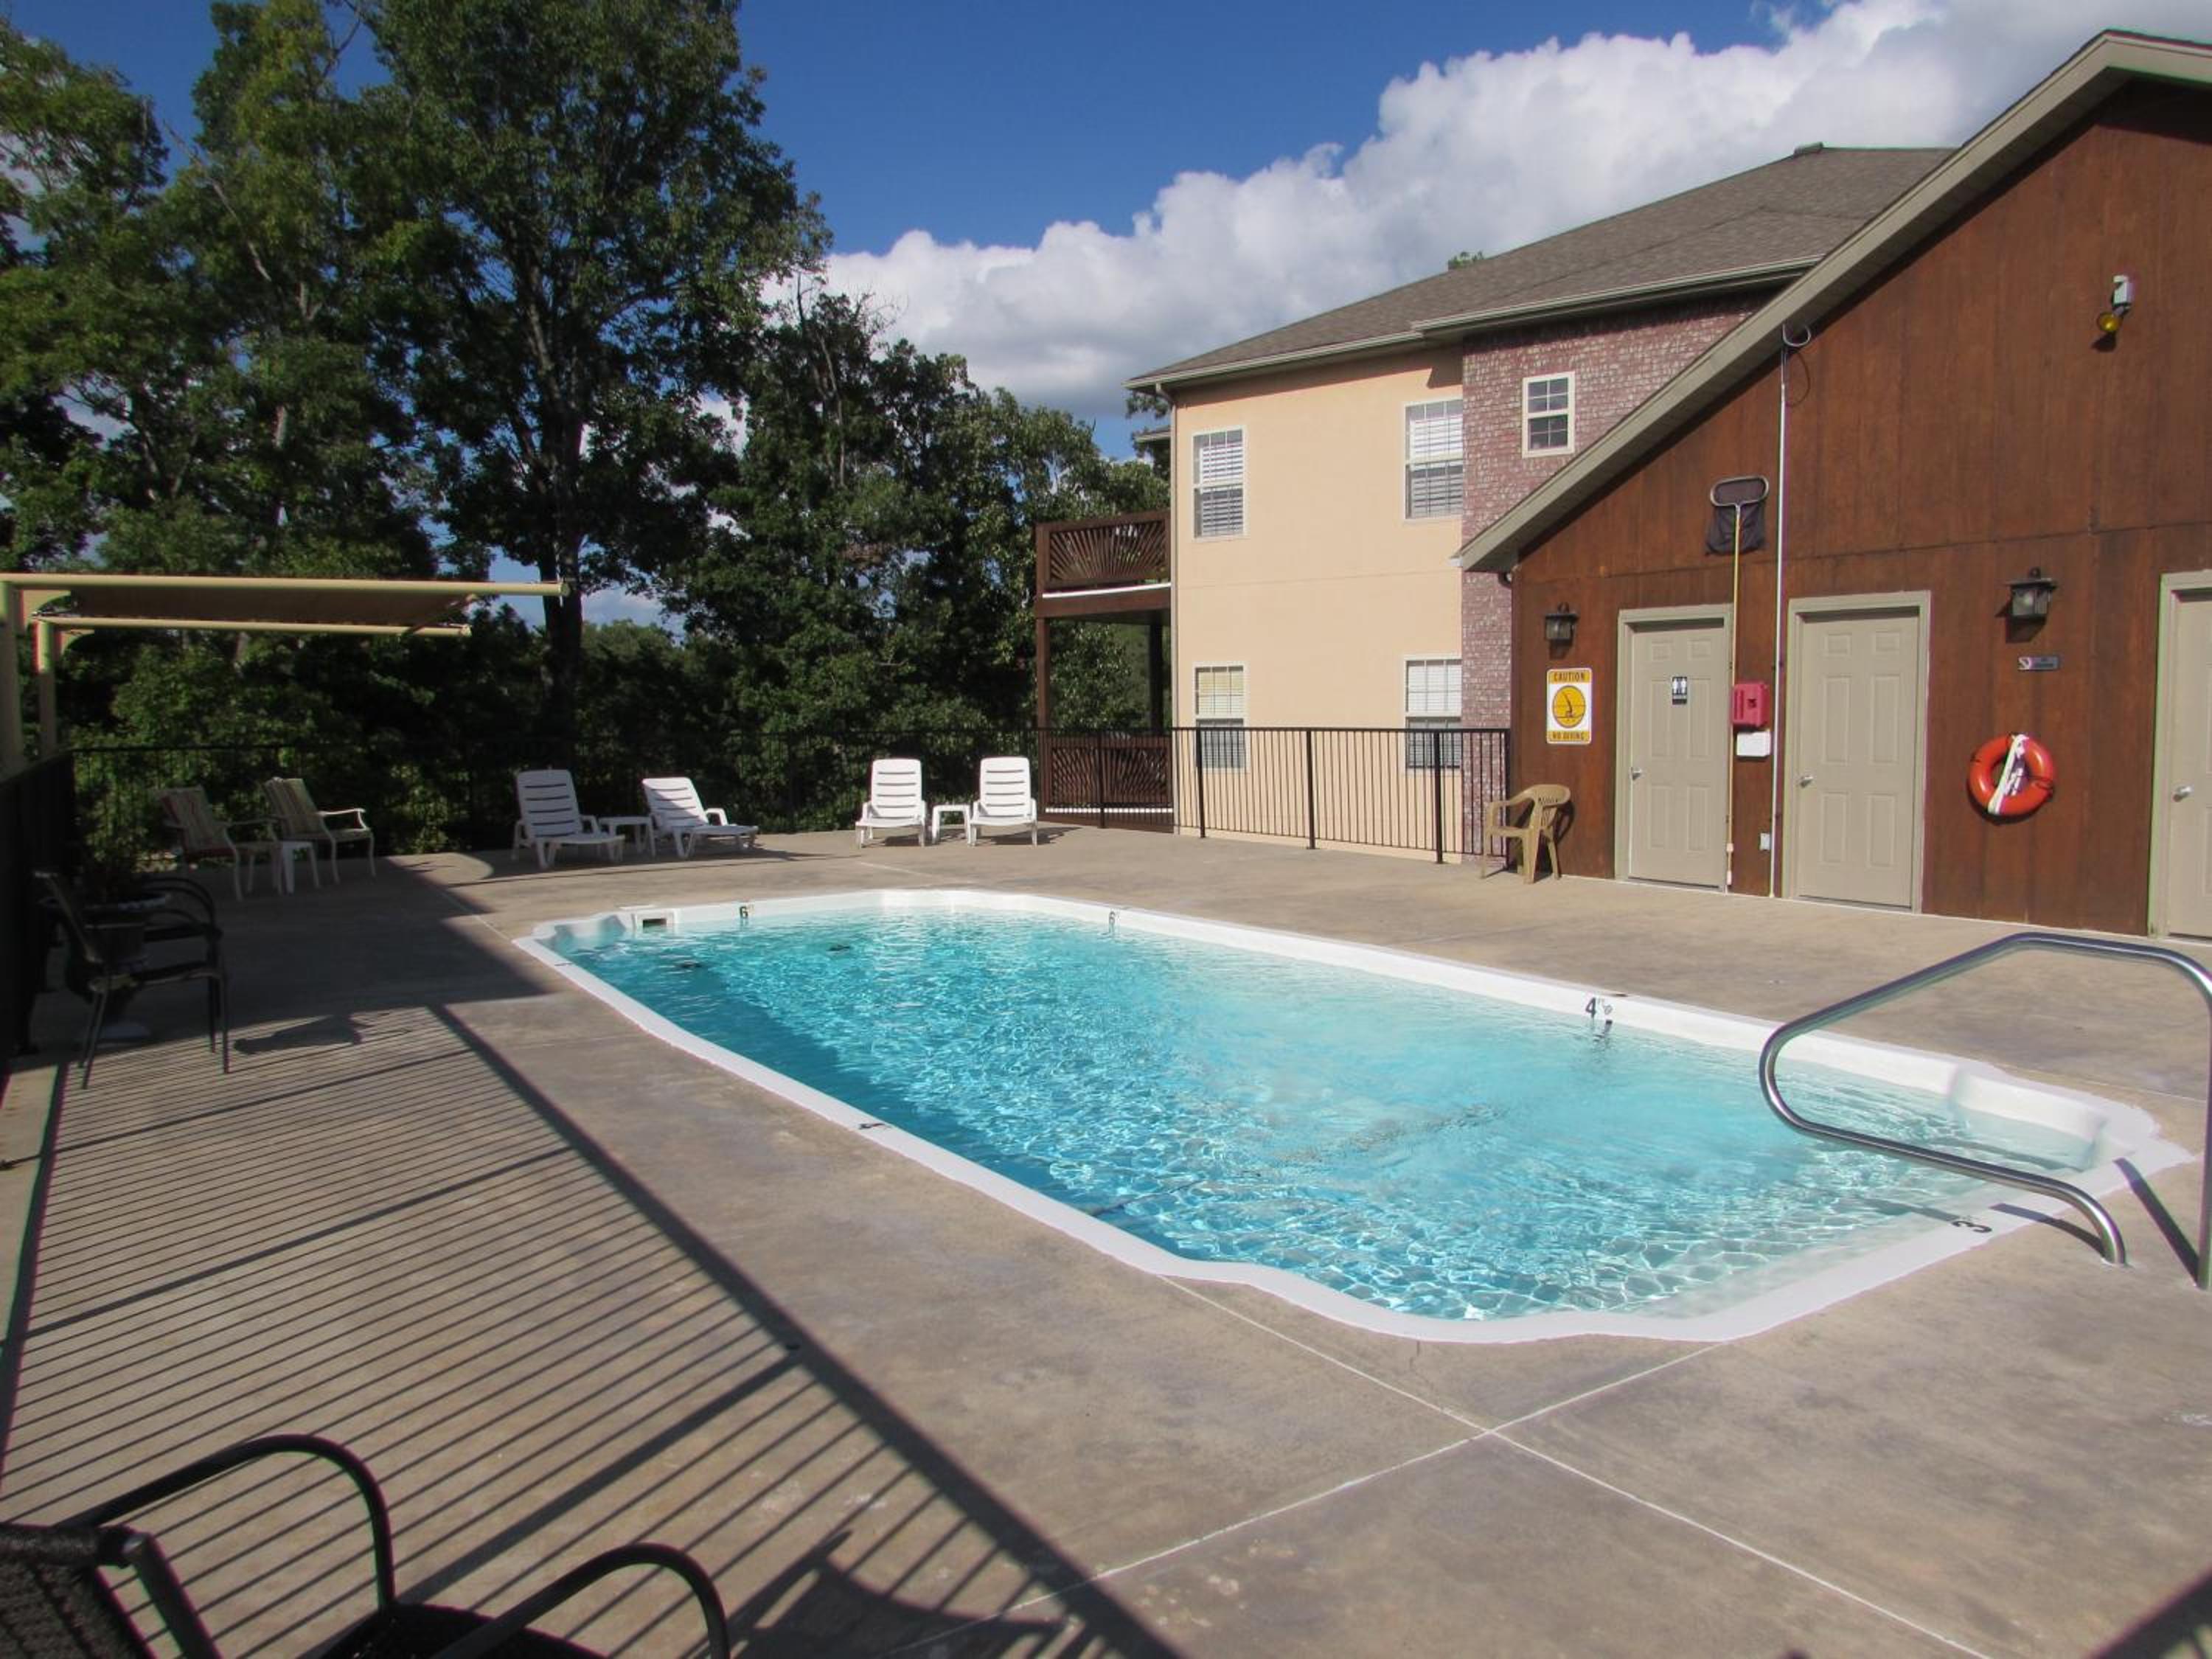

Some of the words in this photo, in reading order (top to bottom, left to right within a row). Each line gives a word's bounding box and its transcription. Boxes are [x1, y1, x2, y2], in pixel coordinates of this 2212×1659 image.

[1554, 672, 1585, 682] CAUTION
[1552, 731, 1562, 740] NO
[1562, 731, 1585, 740] DIVING
